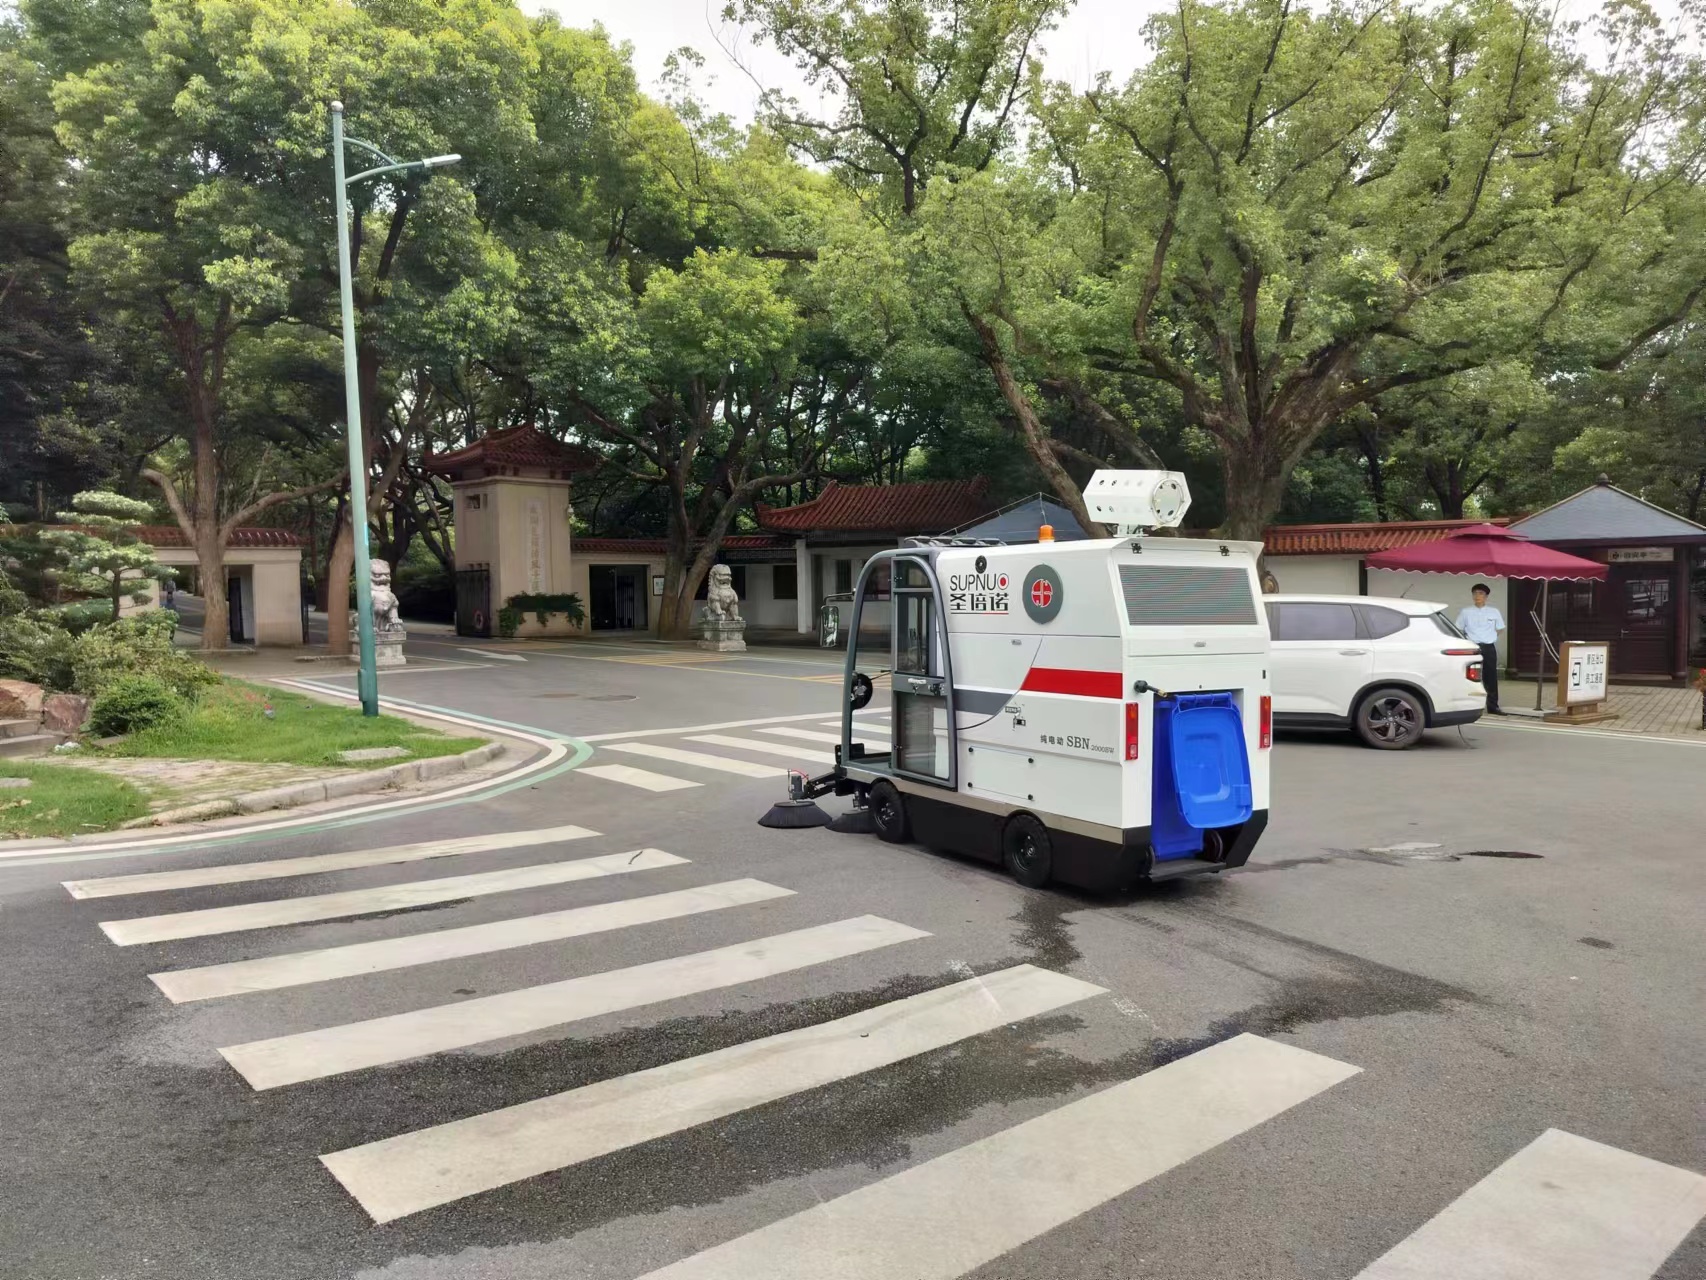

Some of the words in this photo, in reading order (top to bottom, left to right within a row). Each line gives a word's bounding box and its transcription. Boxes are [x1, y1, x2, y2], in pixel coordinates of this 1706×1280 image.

[950, 573, 1009, 591] SUPNUO
[950, 593, 1009, 611] 圣倍诺
[1040, 734, 1064, 746] 纯电动
[1066, 735, 1090, 750] SBN
